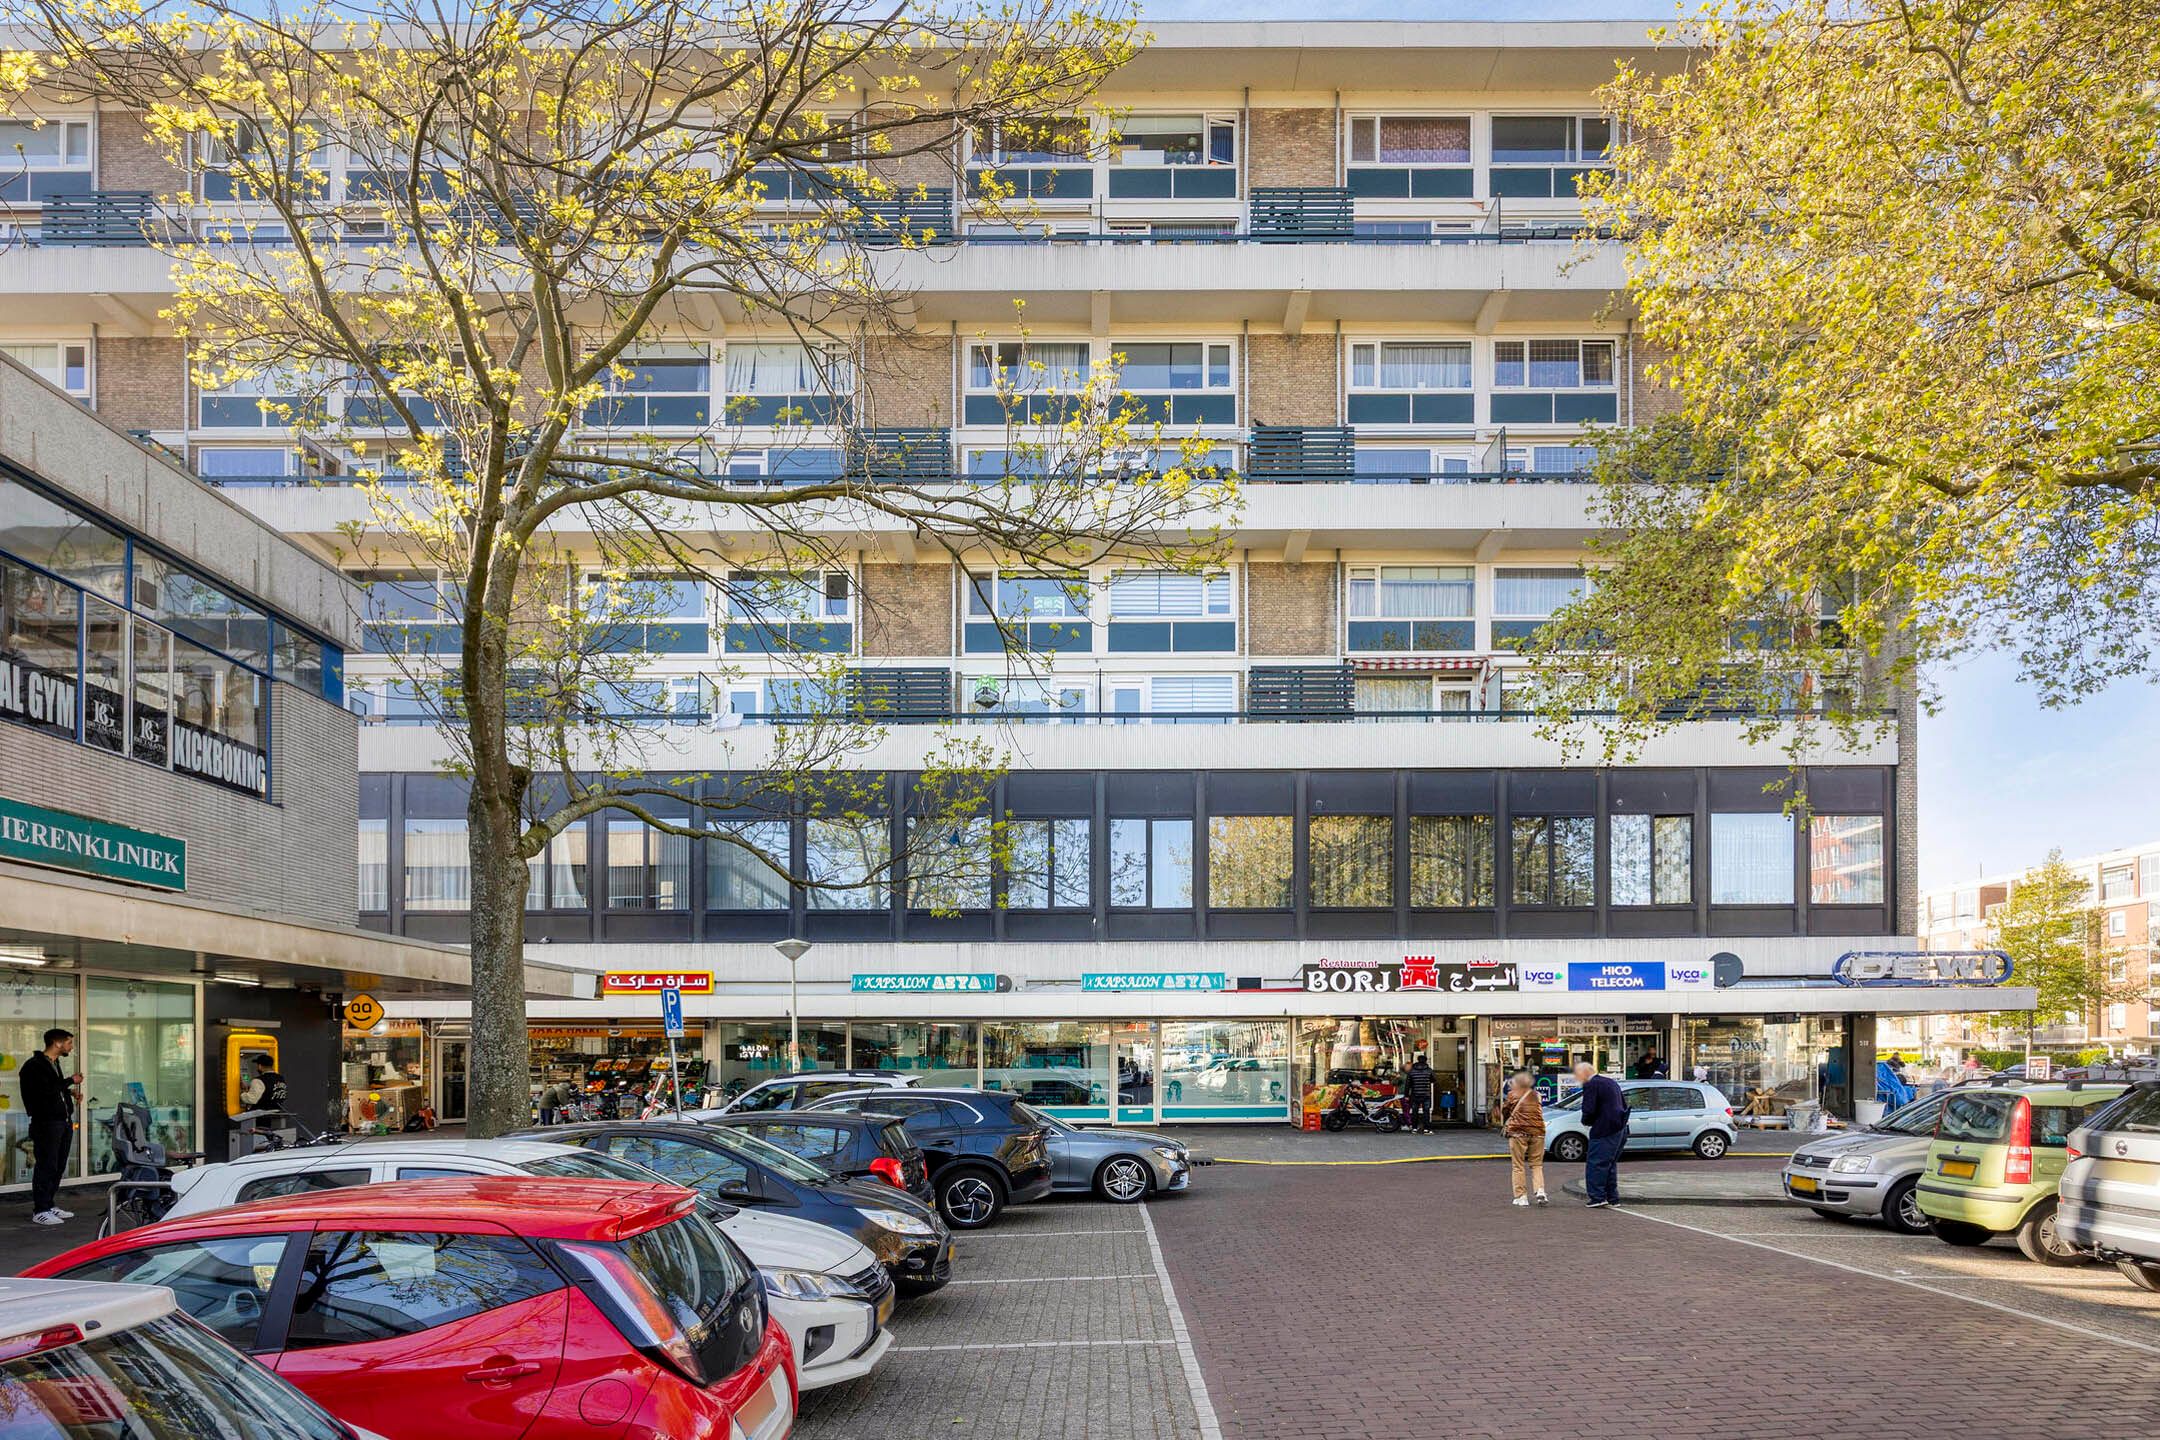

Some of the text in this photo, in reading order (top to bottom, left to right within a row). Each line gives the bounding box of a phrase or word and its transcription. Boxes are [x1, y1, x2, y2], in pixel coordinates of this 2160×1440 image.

[28, 671, 75, 730] GYM
[174, 724, 266, 793] KICKBOXING
[1, 815, 181, 875] IERENKLINIEK
[1319, 958, 1379, 969] Restaurant
[1602, 966, 1632, 975] HICO
[1850, 956, 1997, 979] DEWI
[1307, 970, 1391, 993] BORJ
[1450, 967, 1516, 993] البرج
[1525, 970, 1554, 982] Lyca
[1671, 969, 1700, 980] Lyca
[608, 975, 707, 990] سارة ماركت
[863, 976, 981, 990] KAPSALON ASYA
[1093, 975, 1211, 989] KAPSALON ASYA
[1590, 977, 1645, 988] TELECOM
[666, 991, 678, 1014] P
[1495, 1021, 1518, 1031] Lyca
